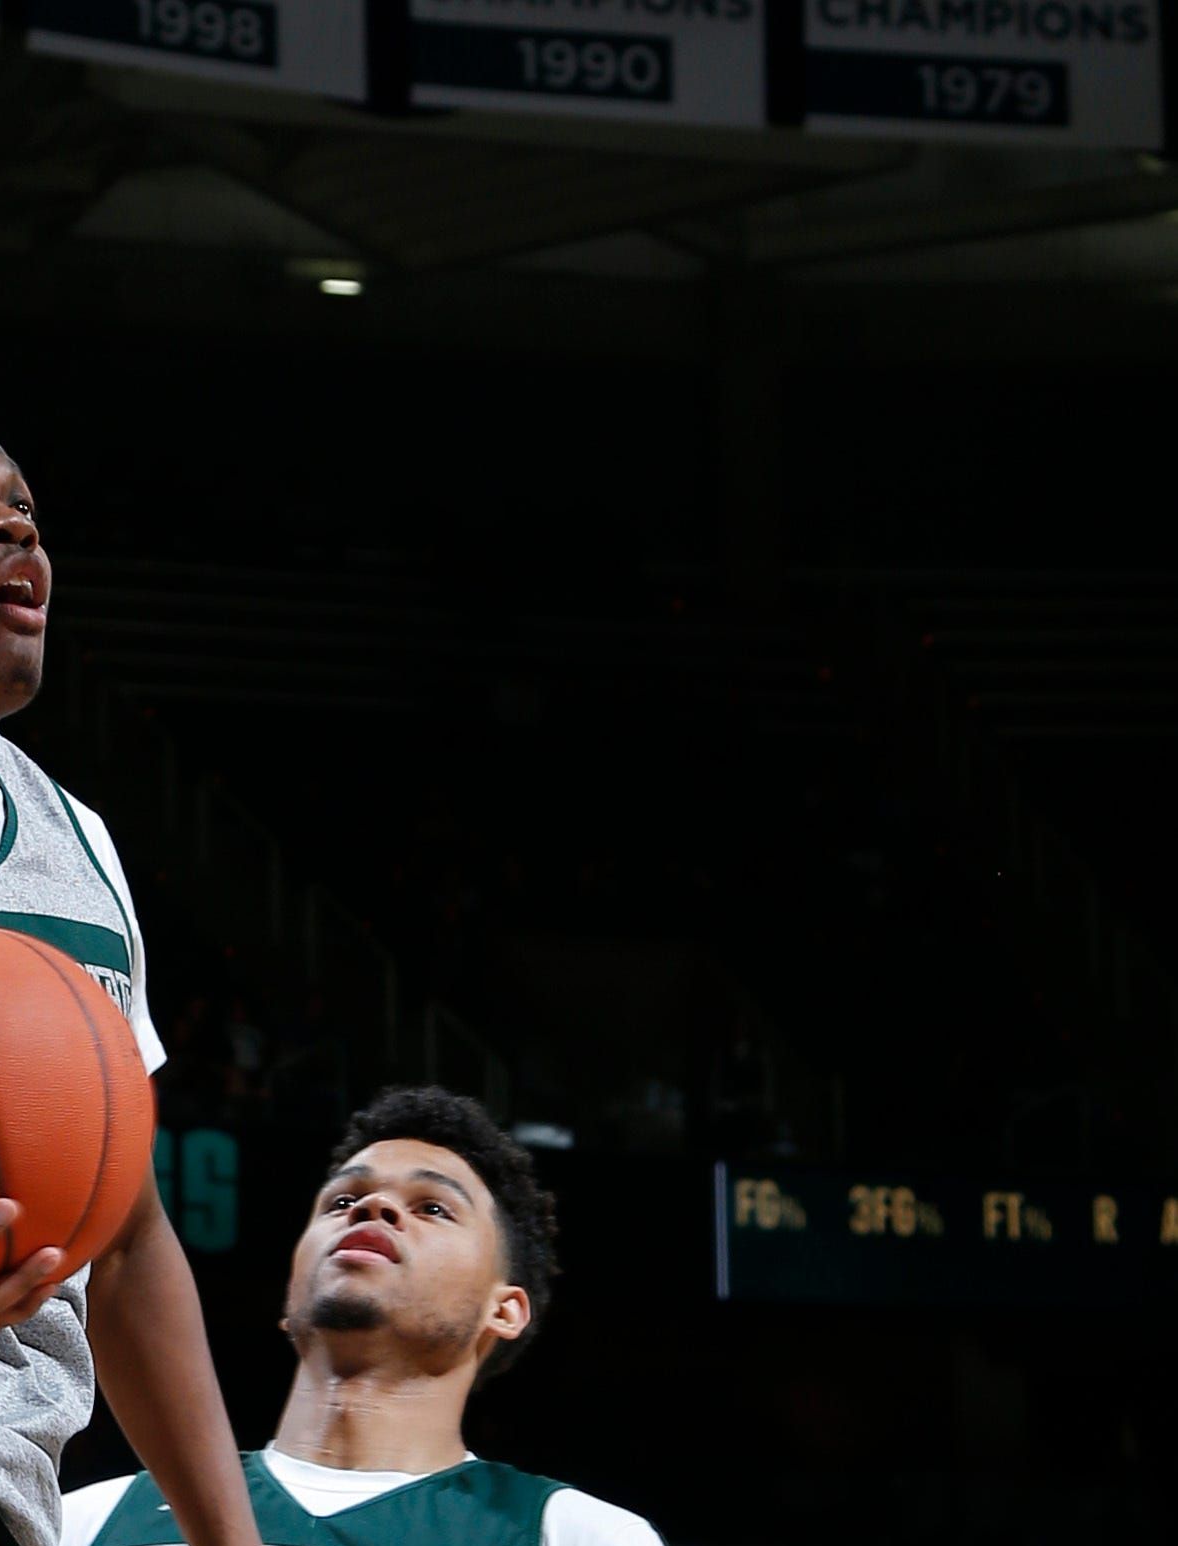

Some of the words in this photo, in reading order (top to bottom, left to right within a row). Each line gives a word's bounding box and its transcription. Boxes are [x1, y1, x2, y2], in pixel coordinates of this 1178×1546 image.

[135, 0, 265, 57] 1998
[823, 0, 1149, 43] CHAMPIONS
[514, 35, 663, 93] 1990
[915, 62, 1054, 118] 1979
